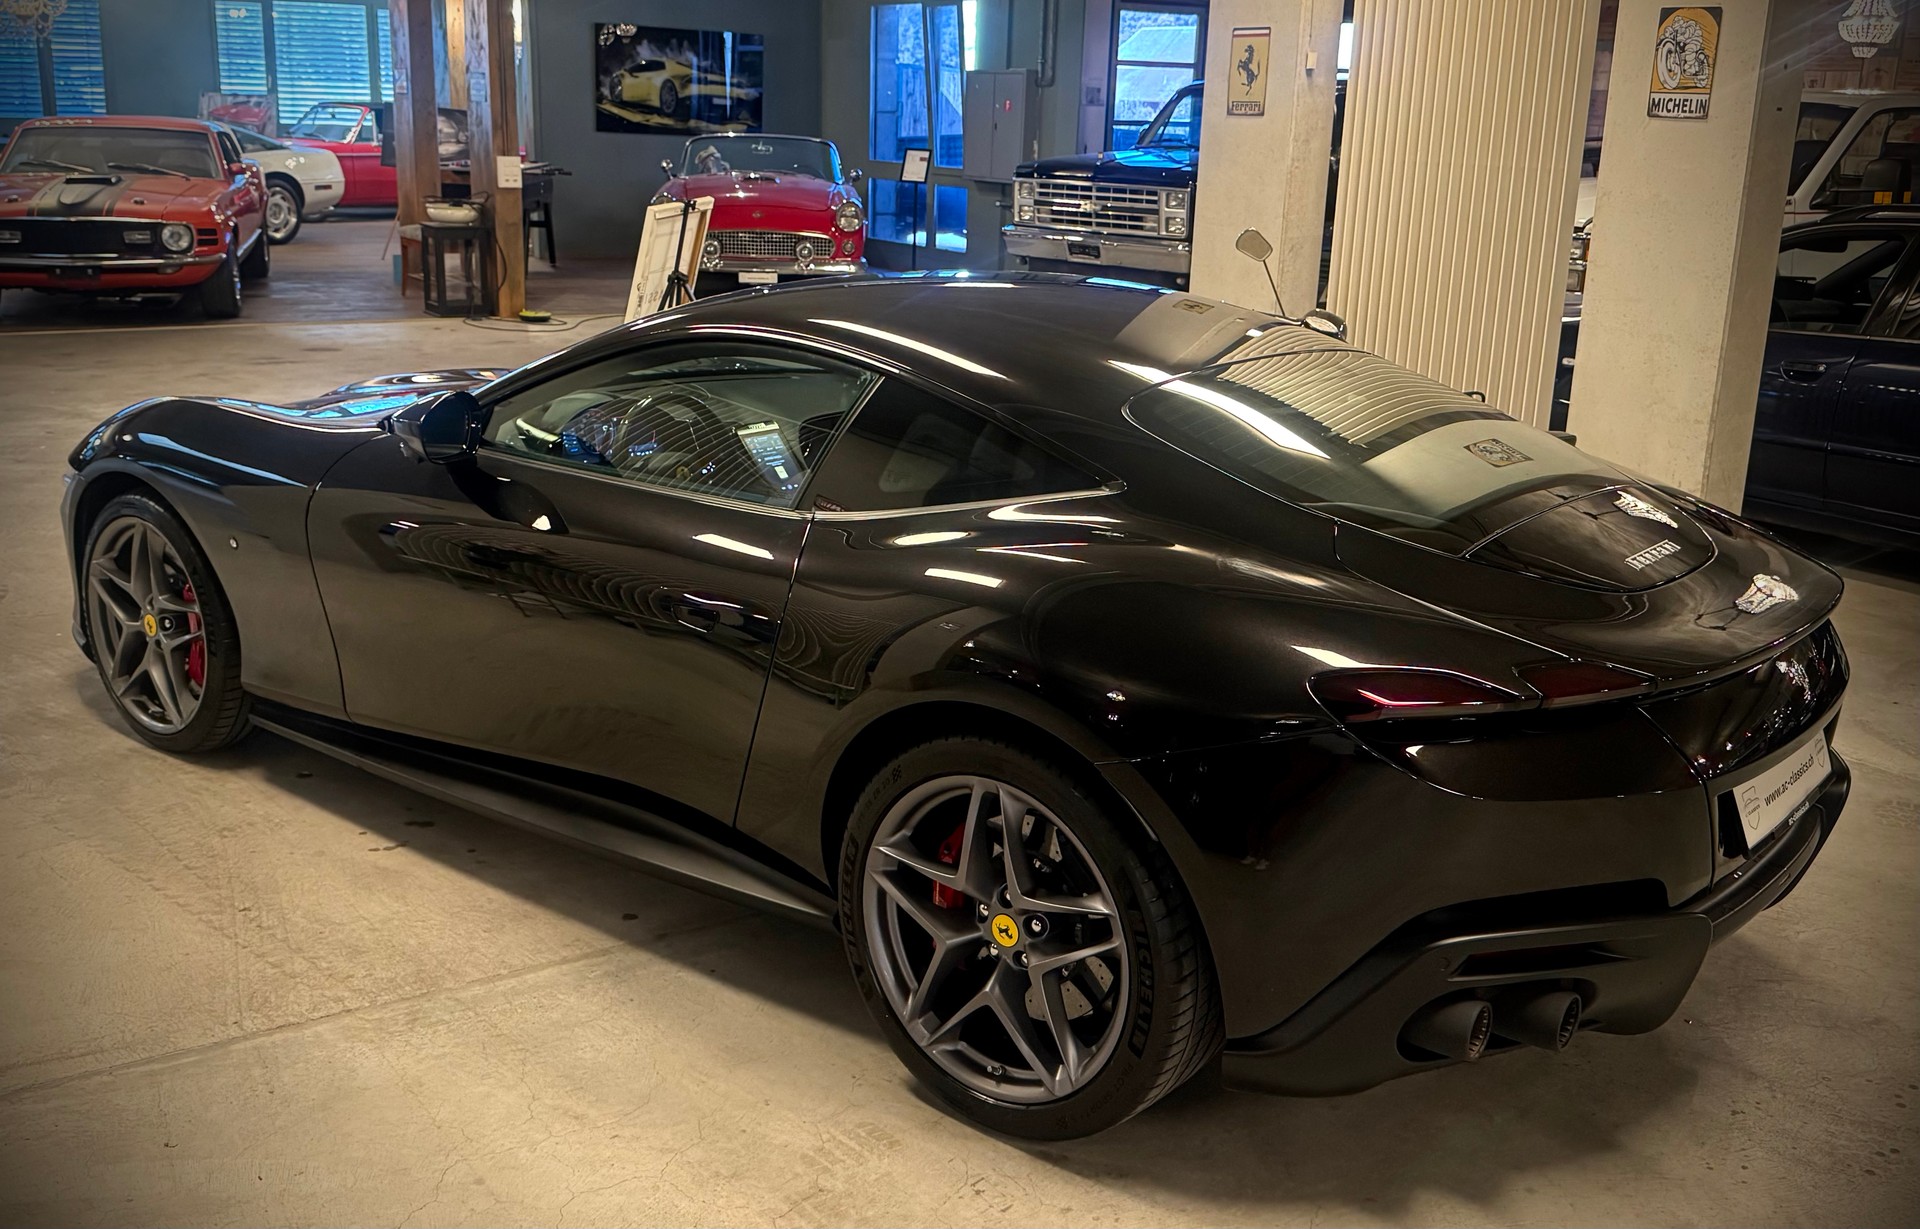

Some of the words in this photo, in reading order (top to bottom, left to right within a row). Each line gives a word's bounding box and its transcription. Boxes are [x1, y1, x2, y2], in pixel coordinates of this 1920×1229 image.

[1231, 101, 1261, 112] Ferrari
[1650, 98, 1708, 115] MICHELIN
[1763, 754, 1815, 807] www.ac-classics.ch
